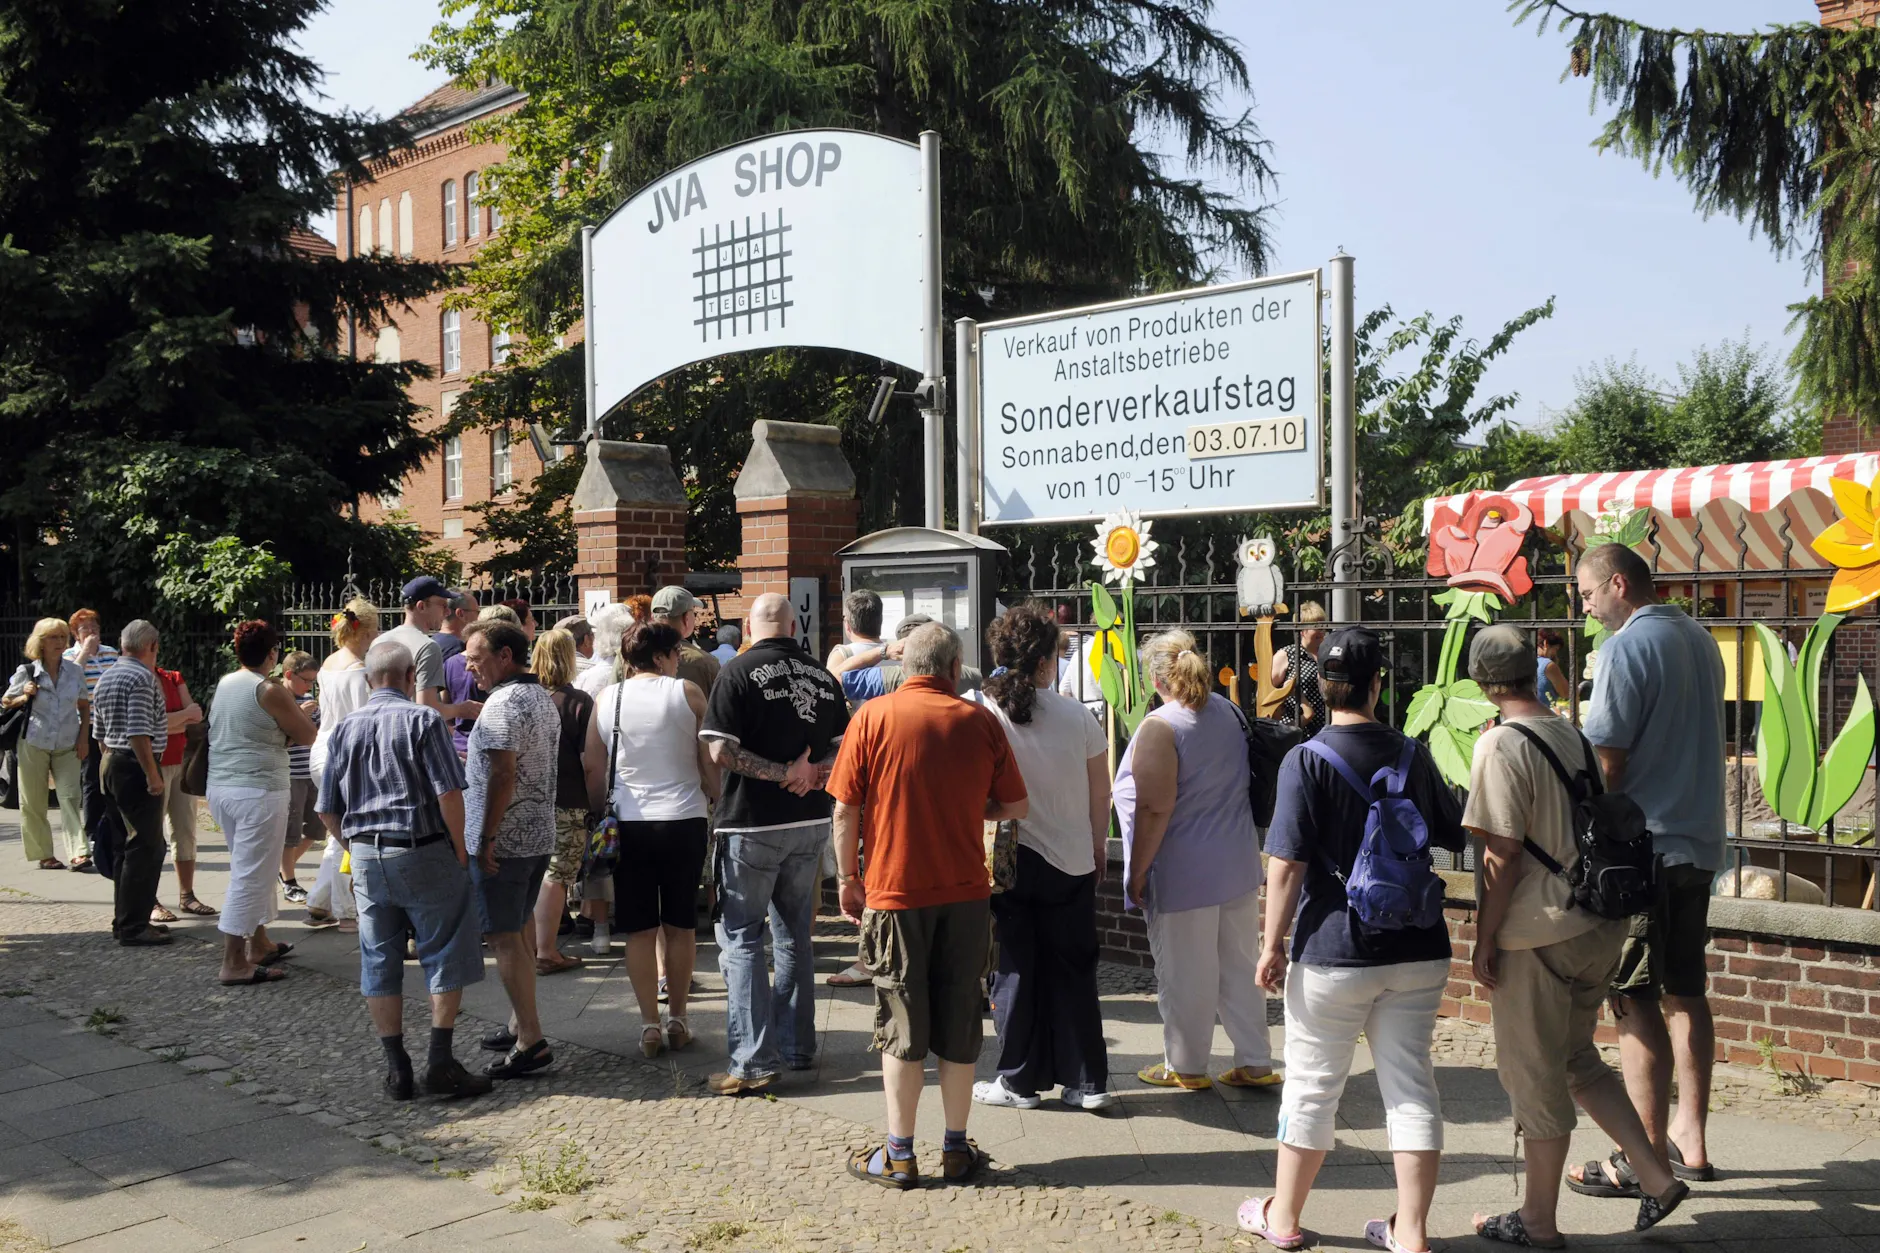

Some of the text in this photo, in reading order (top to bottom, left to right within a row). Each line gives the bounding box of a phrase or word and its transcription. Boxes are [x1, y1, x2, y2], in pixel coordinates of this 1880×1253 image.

[648, 141, 842, 234] JVA SHOP
[722, 243, 760, 262] JVA
[708, 289, 778, 313] TEGEL
[1004, 297, 1292, 359] Verkauf von Produkten der
[1054, 338, 1230, 382] Anstaltsbetriebe
[1001, 374, 1296, 435] Sonderverkaufstag
[1193, 421, 1297, 453] 03.07.10
[1046, 480, 1085, 500] von
[1189, 464, 1235, 490] Uhr
